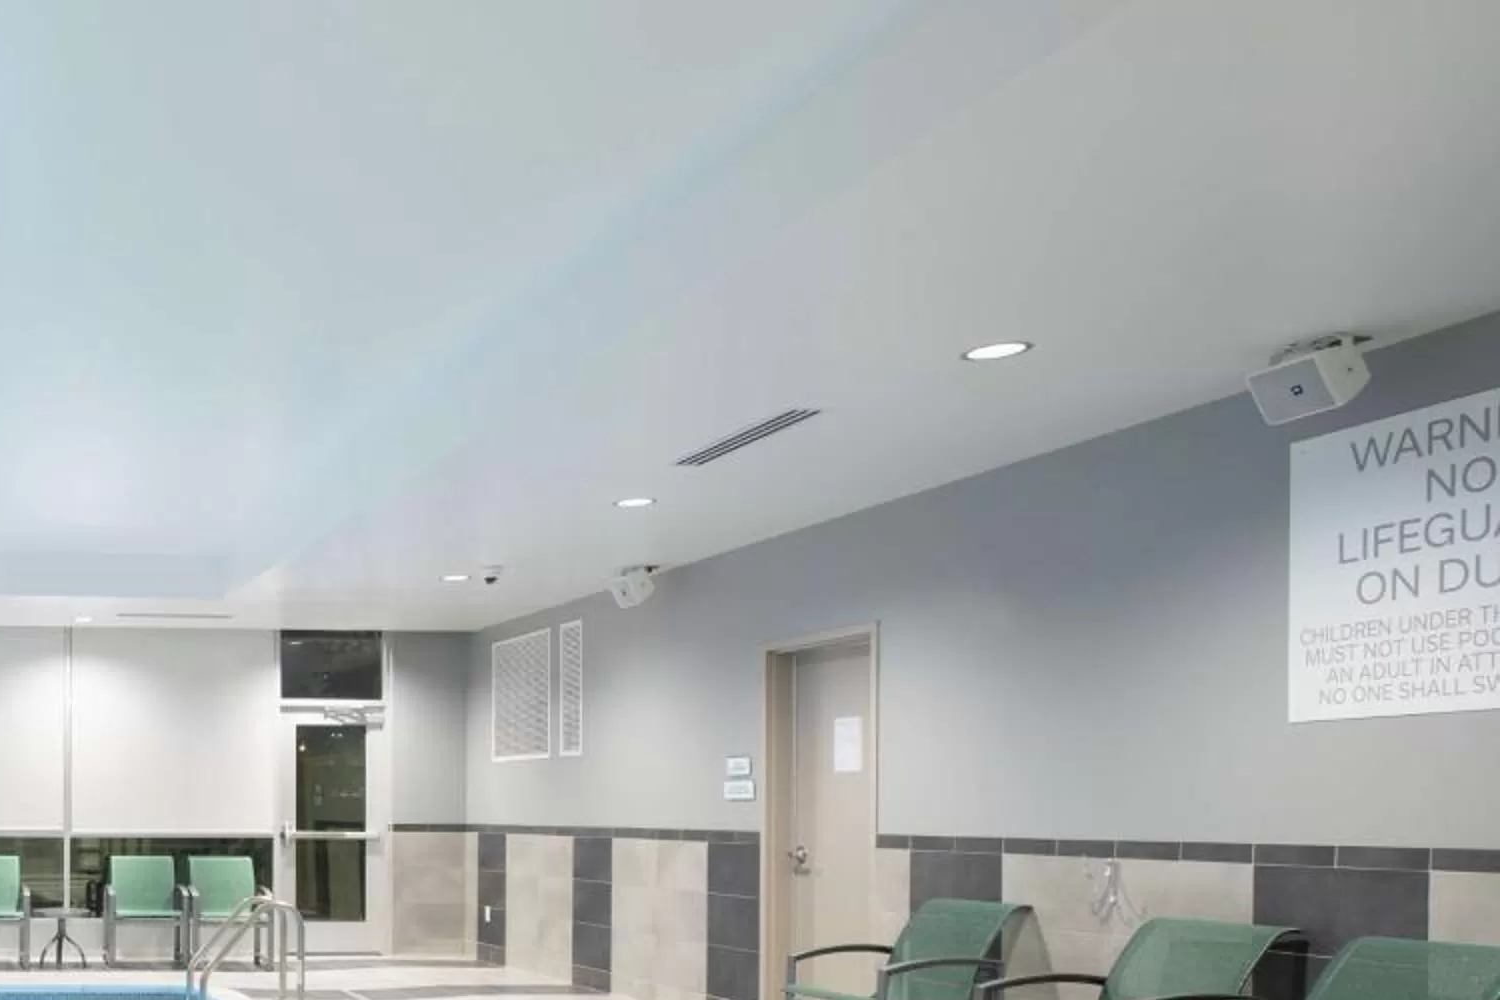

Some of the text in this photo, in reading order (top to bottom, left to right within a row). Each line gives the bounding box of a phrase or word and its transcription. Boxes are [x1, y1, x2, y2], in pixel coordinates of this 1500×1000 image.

[1427, 455, 1497, 502] NO
[1356, 564, 1419, 604] ON
[1299, 618, 1391, 645] CHILDREN
[1399, 607, 1473, 635] UNDER
[1304, 642, 1360, 668] MUST
[1363, 636, 1405, 659] NOT
[1411, 631, 1453, 654] USE
[1326, 666, 1353, 685] AN
[1360, 658, 1422, 681] ADULT
[1429, 655, 1451, 675] IN
[1318, 686, 1347, 705] NO
[1351, 682, 1394, 703] ONE
[1398, 677, 1467, 699] SHALL
